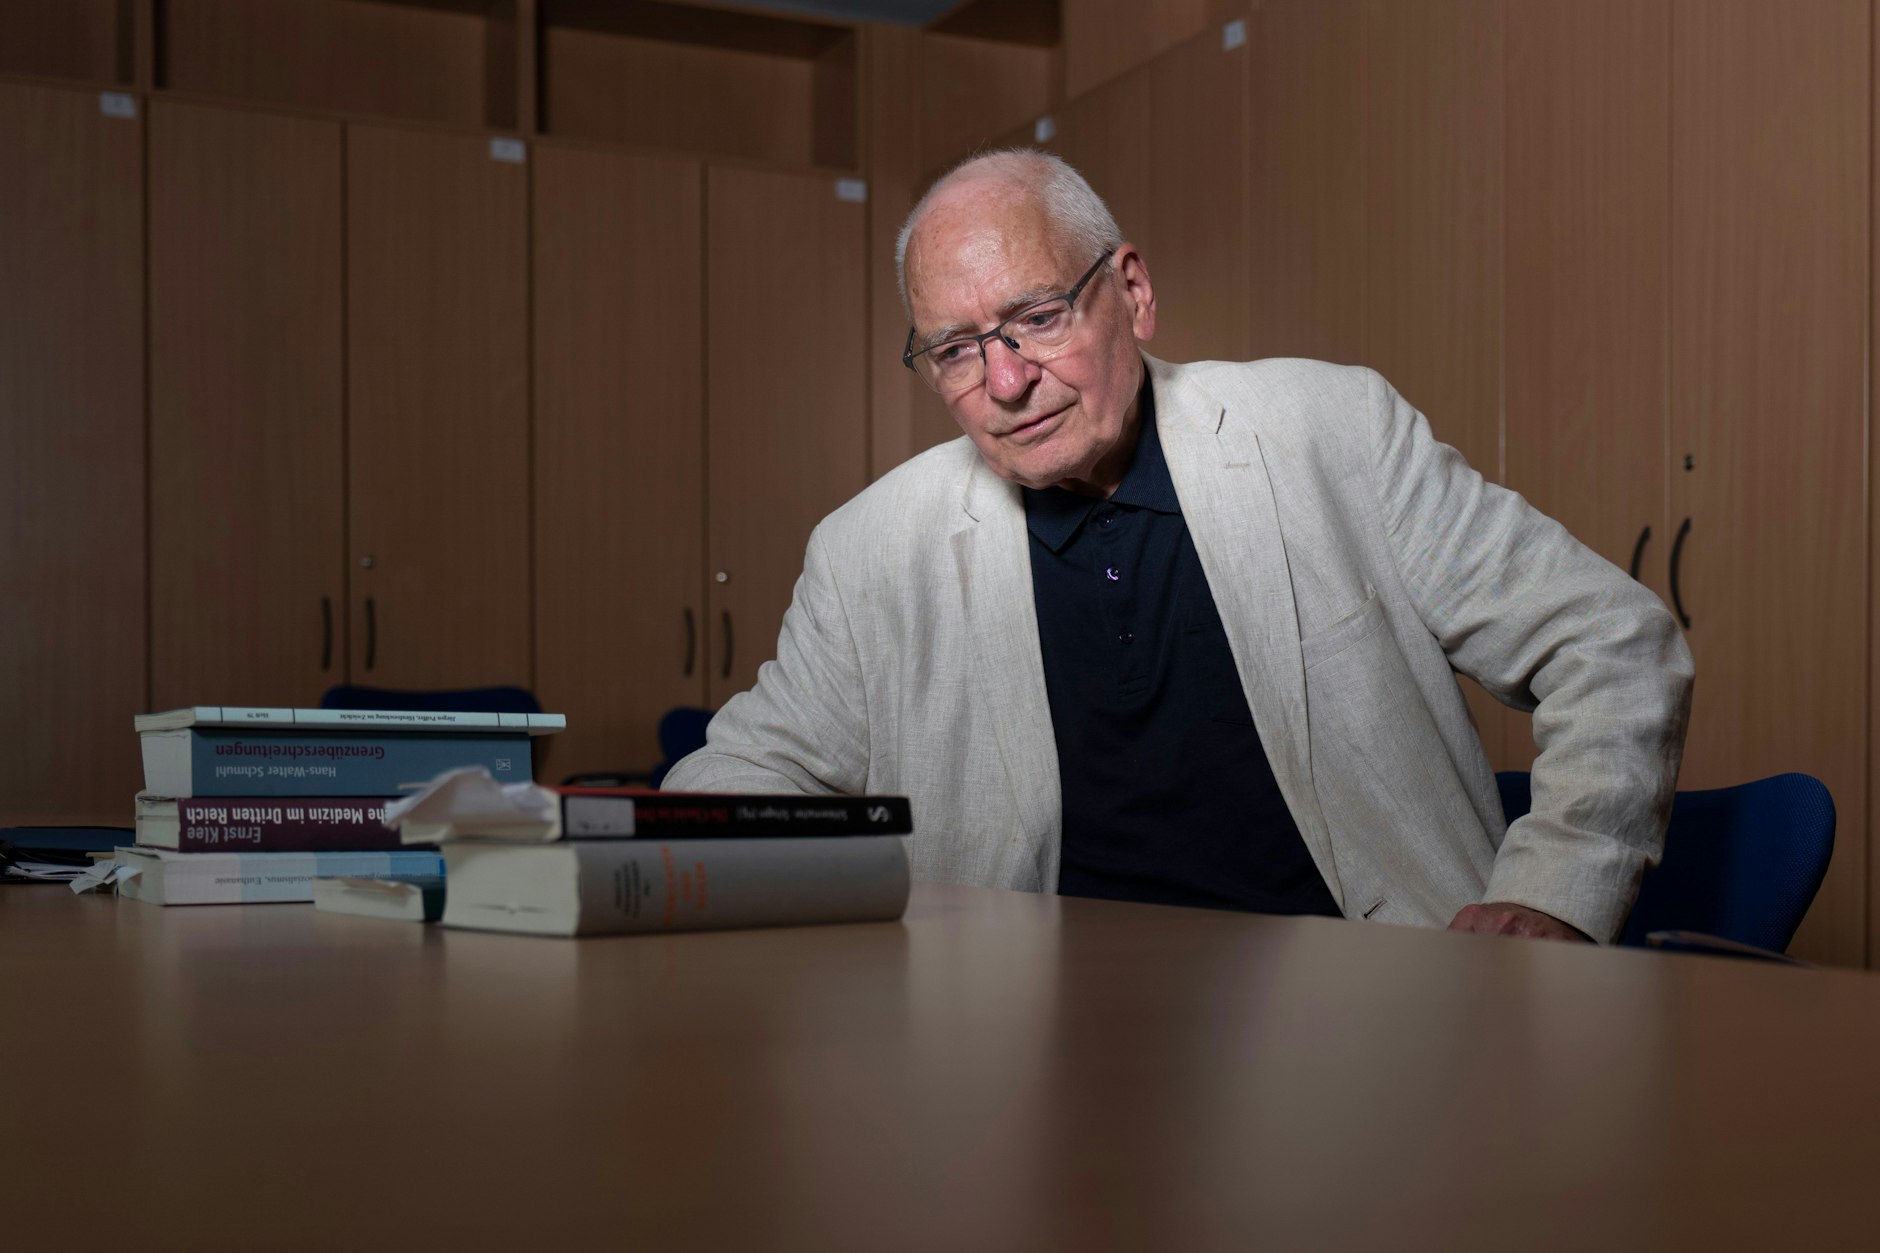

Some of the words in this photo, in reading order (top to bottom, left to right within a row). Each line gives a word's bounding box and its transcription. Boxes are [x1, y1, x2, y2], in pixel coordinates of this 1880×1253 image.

[215, 741, 385, 760] Grenzüberschreitungen
[215, 765, 265, 777] Schmuhl
[268, 765, 337, 777] Hans-Walter
[186, 807, 228, 824] Reich
[232, 807, 282, 824] Dritten
[286, 807, 305, 824] im
[309, 807, 364, 824] Medizin
[186, 826, 219, 843] Klee
[223, 826, 261, 843] Ernst
